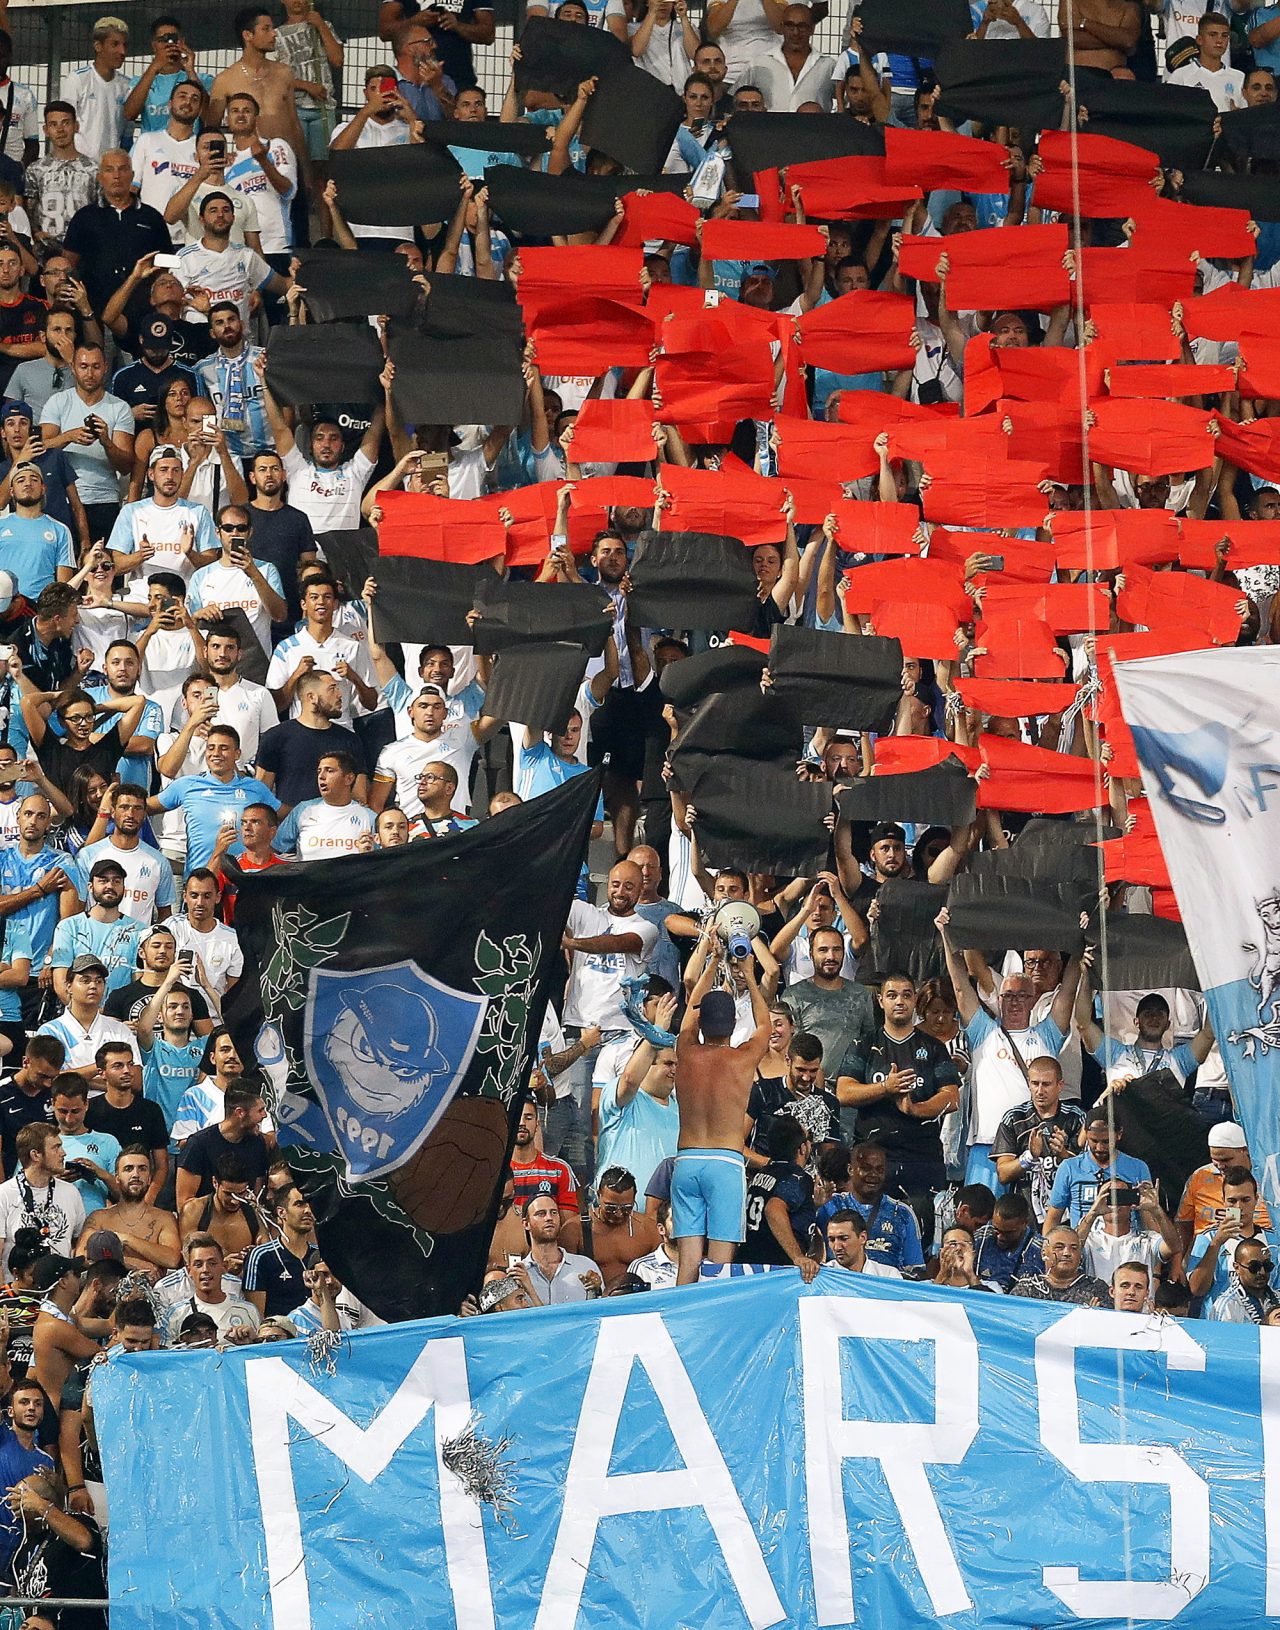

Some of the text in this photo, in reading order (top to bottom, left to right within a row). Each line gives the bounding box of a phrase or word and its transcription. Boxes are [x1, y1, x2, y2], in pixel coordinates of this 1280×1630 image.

[1174, 11, 1200, 24] Oran
[148, 104, 169, 117] Ora
[171, 162, 198, 174] INTER
[171, 170, 193, 179] SPOR
[242, 174, 269, 188] INTER
[243, 183, 267, 193] SPORT
[713, 274, 741, 288] Oran
[560, 375, 594, 388] Oran
[338, 413, 371, 430] Oran
[150, 540, 181, 556] rang
[4, 834, 20, 842] SPO
[124, 887, 149, 902] nge
[100, 951, 128, 967] nge
[159, 1064, 200, 1082] Orang
[872, 1072, 924, 1090] Oge
[6, 1349, 33, 1363] Cha
